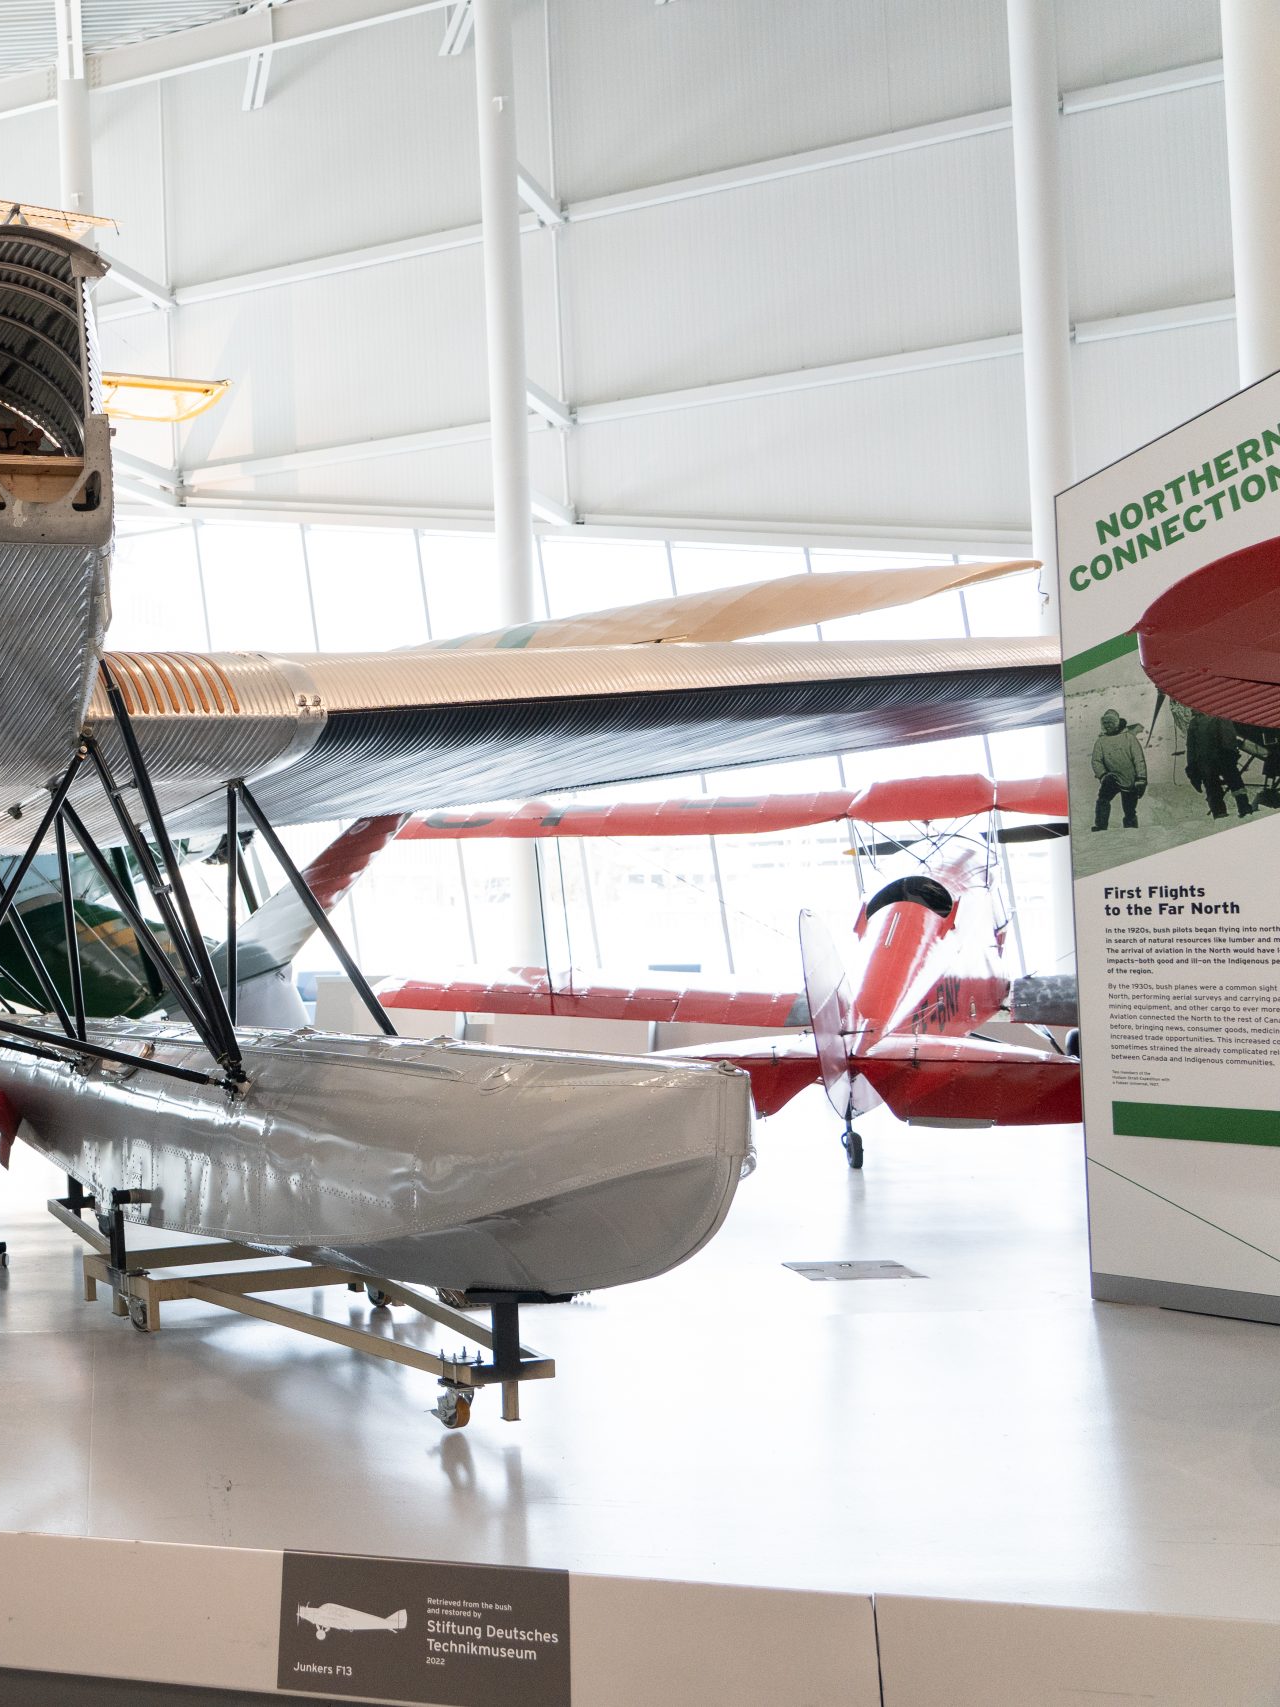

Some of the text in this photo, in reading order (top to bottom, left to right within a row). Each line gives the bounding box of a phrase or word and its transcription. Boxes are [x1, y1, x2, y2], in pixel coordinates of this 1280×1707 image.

[1095, 422, 1280, 545] NORTHERN
[1104, 885, 1205, 900] First Flights
[1105, 901, 1240, 916] to the Far North
[427, 1597, 512, 1611] Retrieved from the bush
[427, 1607, 482, 1619] and restored by
[427, 1620, 559, 1644] Stiftung Deutsches
[427, 1639, 537, 1660] Technikmuseum
[293, 1661, 352, 1676] Junkers F13
[426, 1657, 445, 1665] 2022
